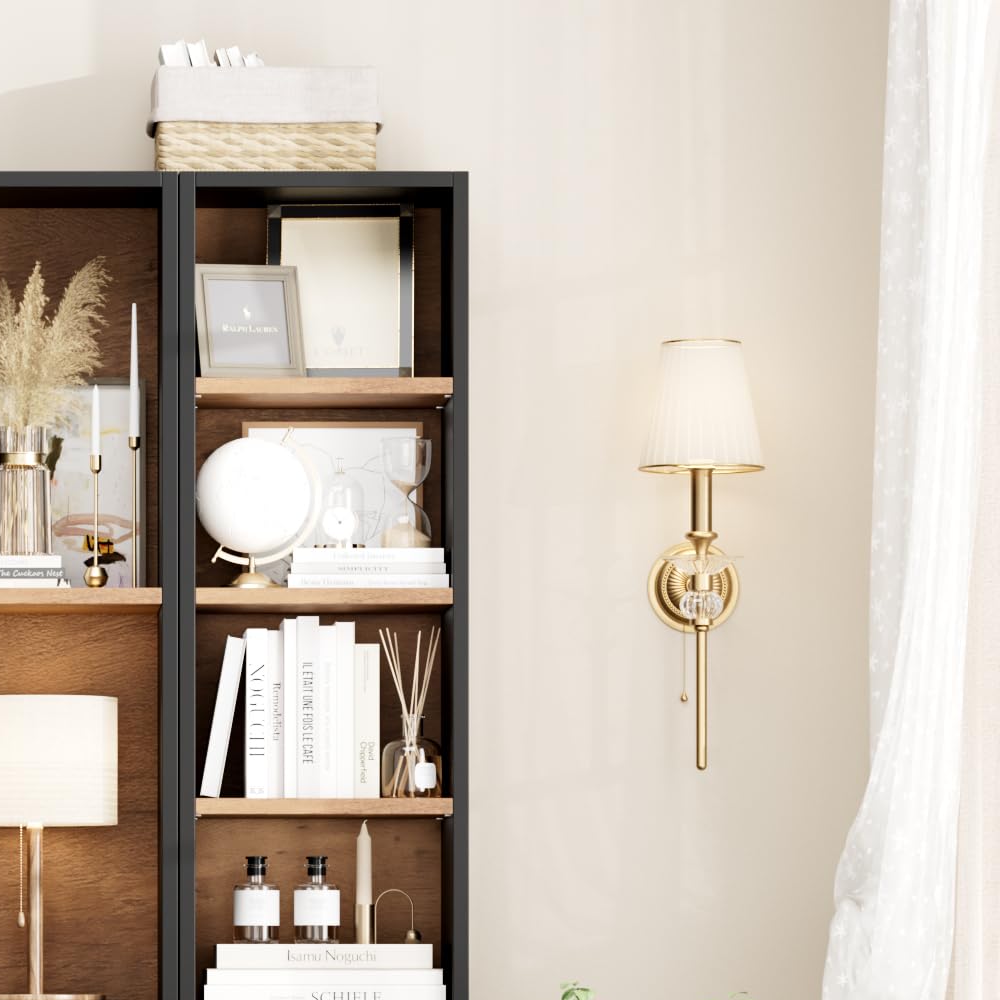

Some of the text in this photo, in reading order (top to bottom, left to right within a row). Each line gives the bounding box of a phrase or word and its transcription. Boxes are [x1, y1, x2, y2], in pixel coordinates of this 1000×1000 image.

[46, 569, 64, 578] Nest
[302, 695, 314, 711] UNE
[273, 682, 283, 741] Remodelista
[302, 713, 314, 731] FOIS
[302, 733, 314, 741] LE
[287, 949, 377, 965] Isamu Noguchi
